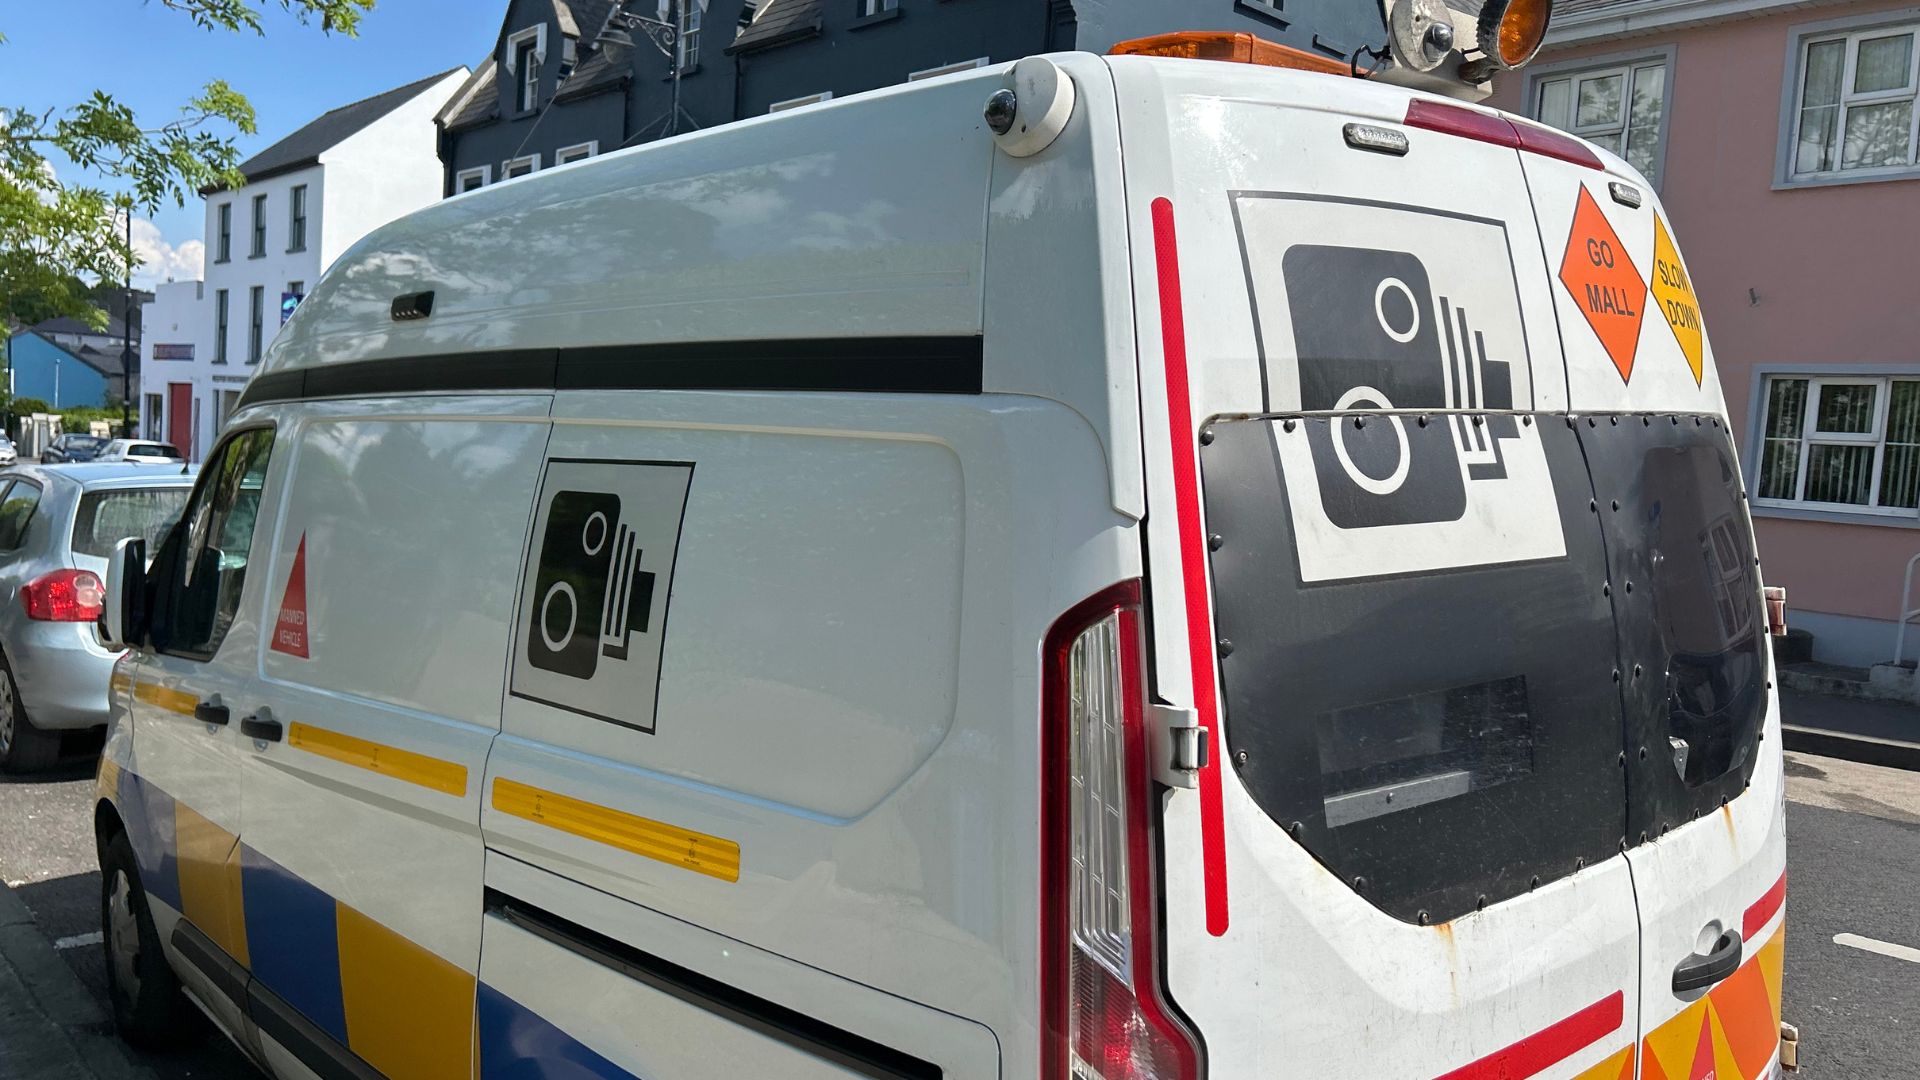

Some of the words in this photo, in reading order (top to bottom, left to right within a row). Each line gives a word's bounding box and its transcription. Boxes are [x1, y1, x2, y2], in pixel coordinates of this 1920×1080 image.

[1587, 238, 1614, 268] GO
[1658, 259, 1689, 293] SLOW
[1585, 284, 1635, 316] MALL
[1667, 299, 1700, 332] DOWN
[280, 629, 302, 648] VEHICLE
